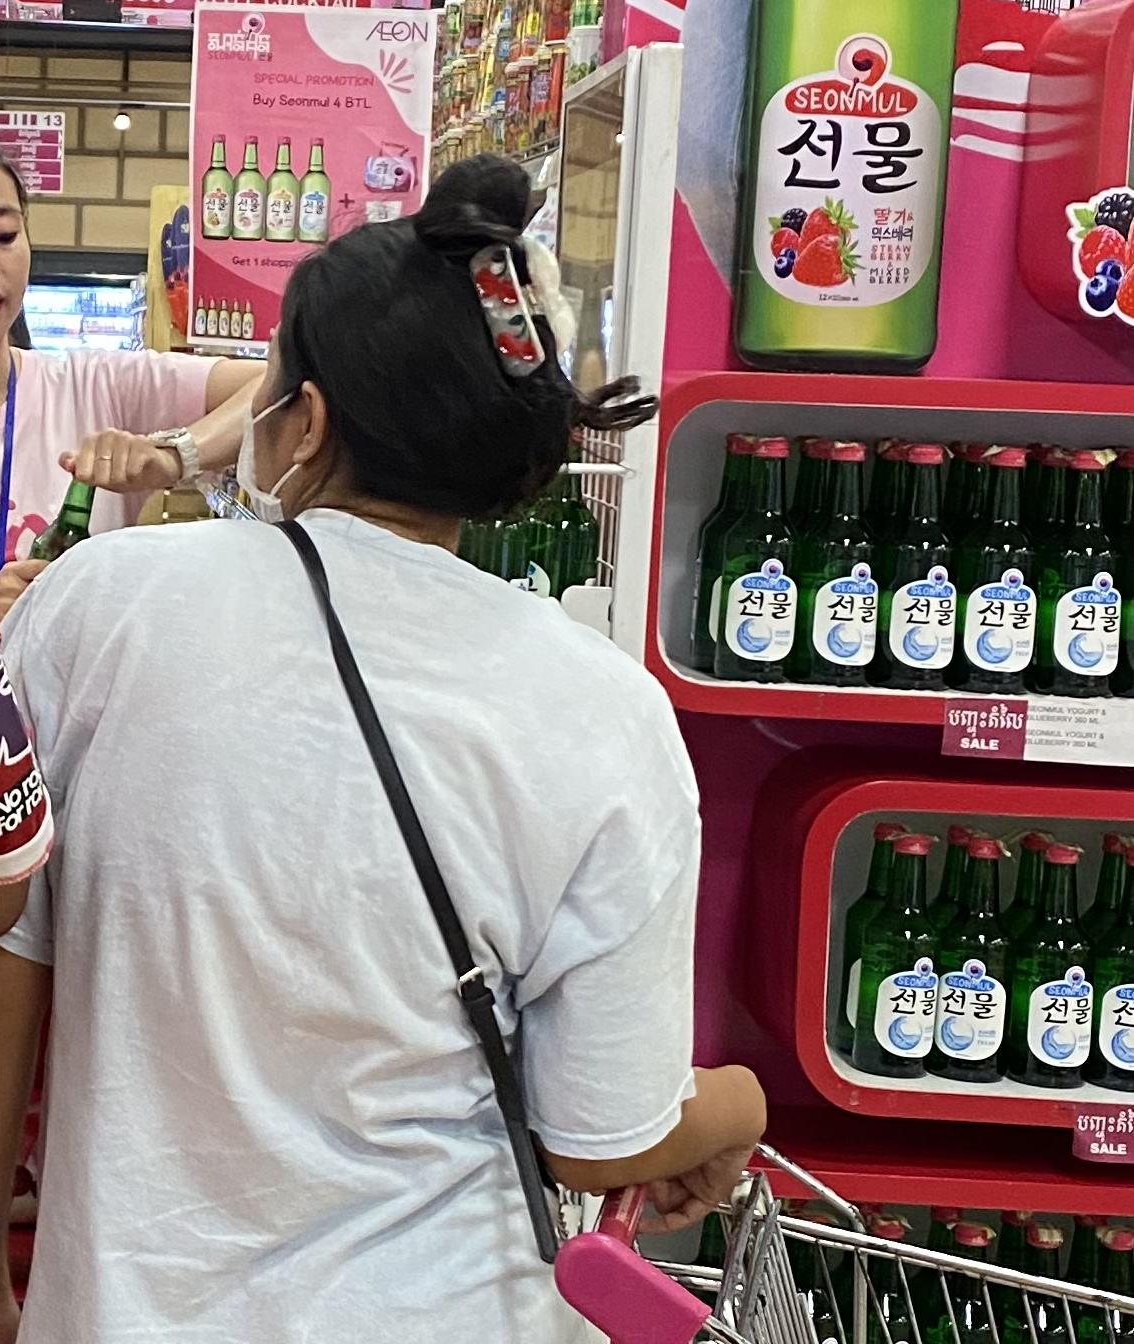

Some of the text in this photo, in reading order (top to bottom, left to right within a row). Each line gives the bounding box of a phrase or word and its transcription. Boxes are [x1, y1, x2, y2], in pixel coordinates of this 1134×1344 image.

[254, 73, 374, 87] SPECIAL PROMOTION
[253, 94, 372, 108] Buy Seonmul 4 BTL
[794, 88, 908, 113] SEONMUL
[44, 115, 62, 127] 13
[232, 256, 250, 266] Get
[870, 267, 910, 276] MIXED
[870, 276, 909, 285] BERRY
[960, 737, 999, 750] SALE
[1090, 1143, 1127, 1154] SALE
